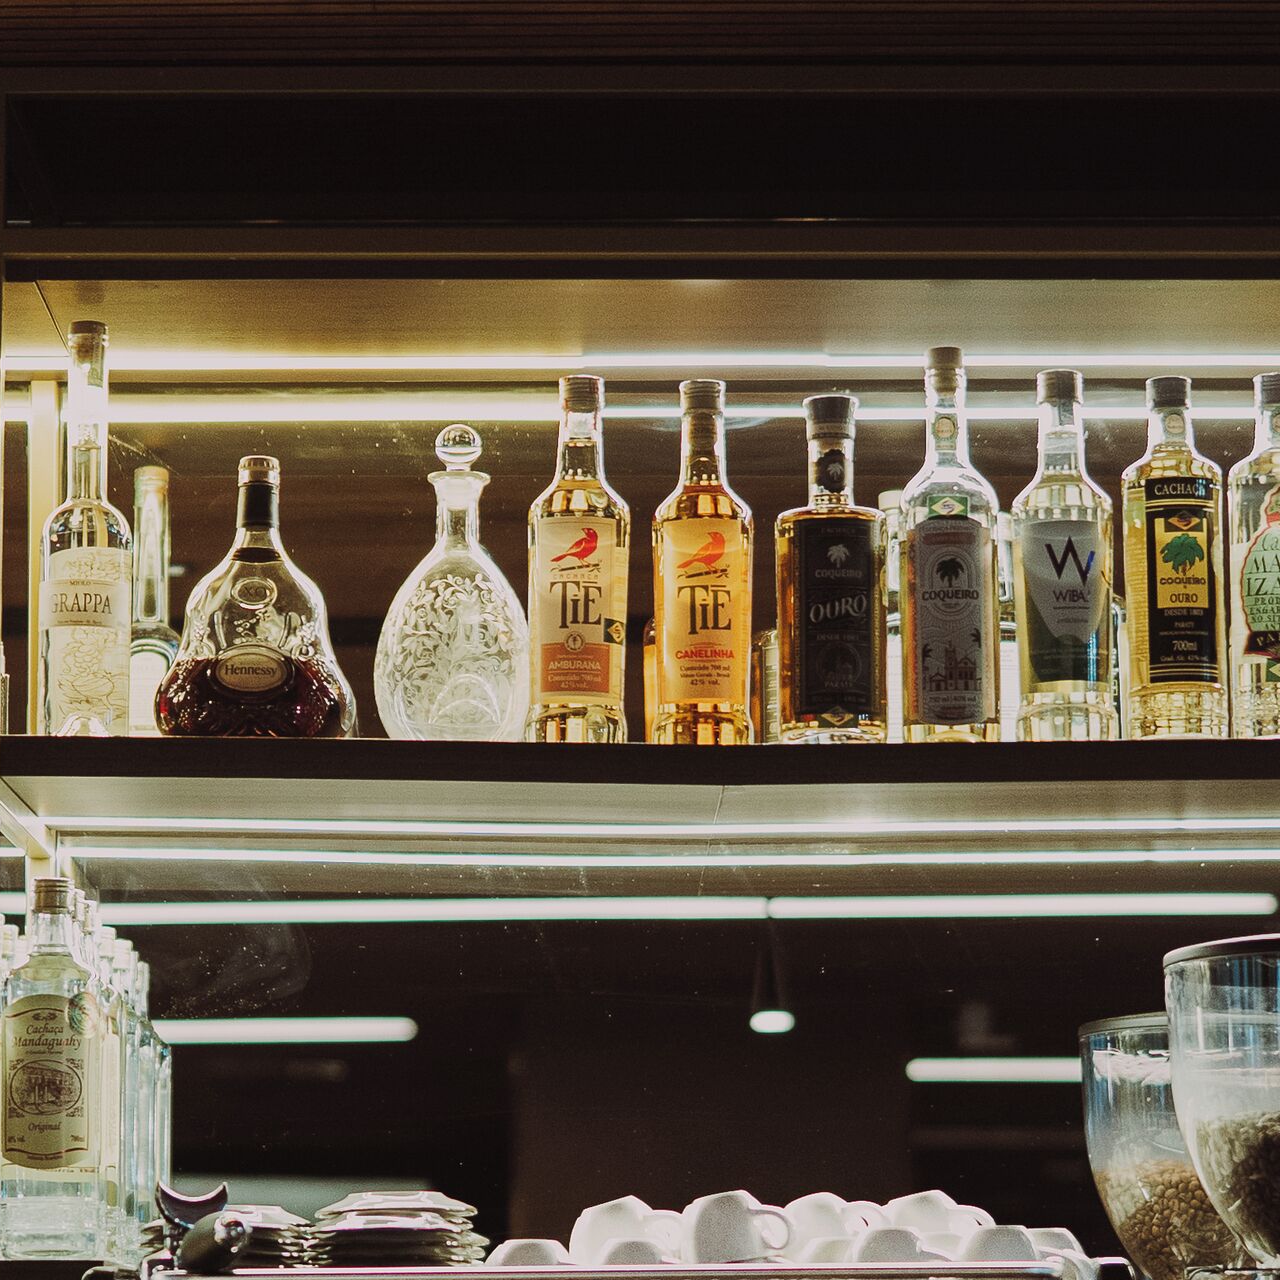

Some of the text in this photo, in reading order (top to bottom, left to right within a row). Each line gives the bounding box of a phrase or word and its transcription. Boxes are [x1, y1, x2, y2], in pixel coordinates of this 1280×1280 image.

[815, 568, 862, 580] COQUEIRO
[922, 589, 979, 601] COQUEIRO
[1170, 593, 1198, 603] OURO
[51, 592, 112, 614] GRAPPA
[809, 591, 867, 624] OURO
[675, 649, 735, 660] CANELINHA
[224, 664, 278, 676] Hennessy
[548, 660, 601, 670] AMBURANA
[26, 1023, 64, 1035] Cachaça
[28, 1121, 61, 1133] Original
